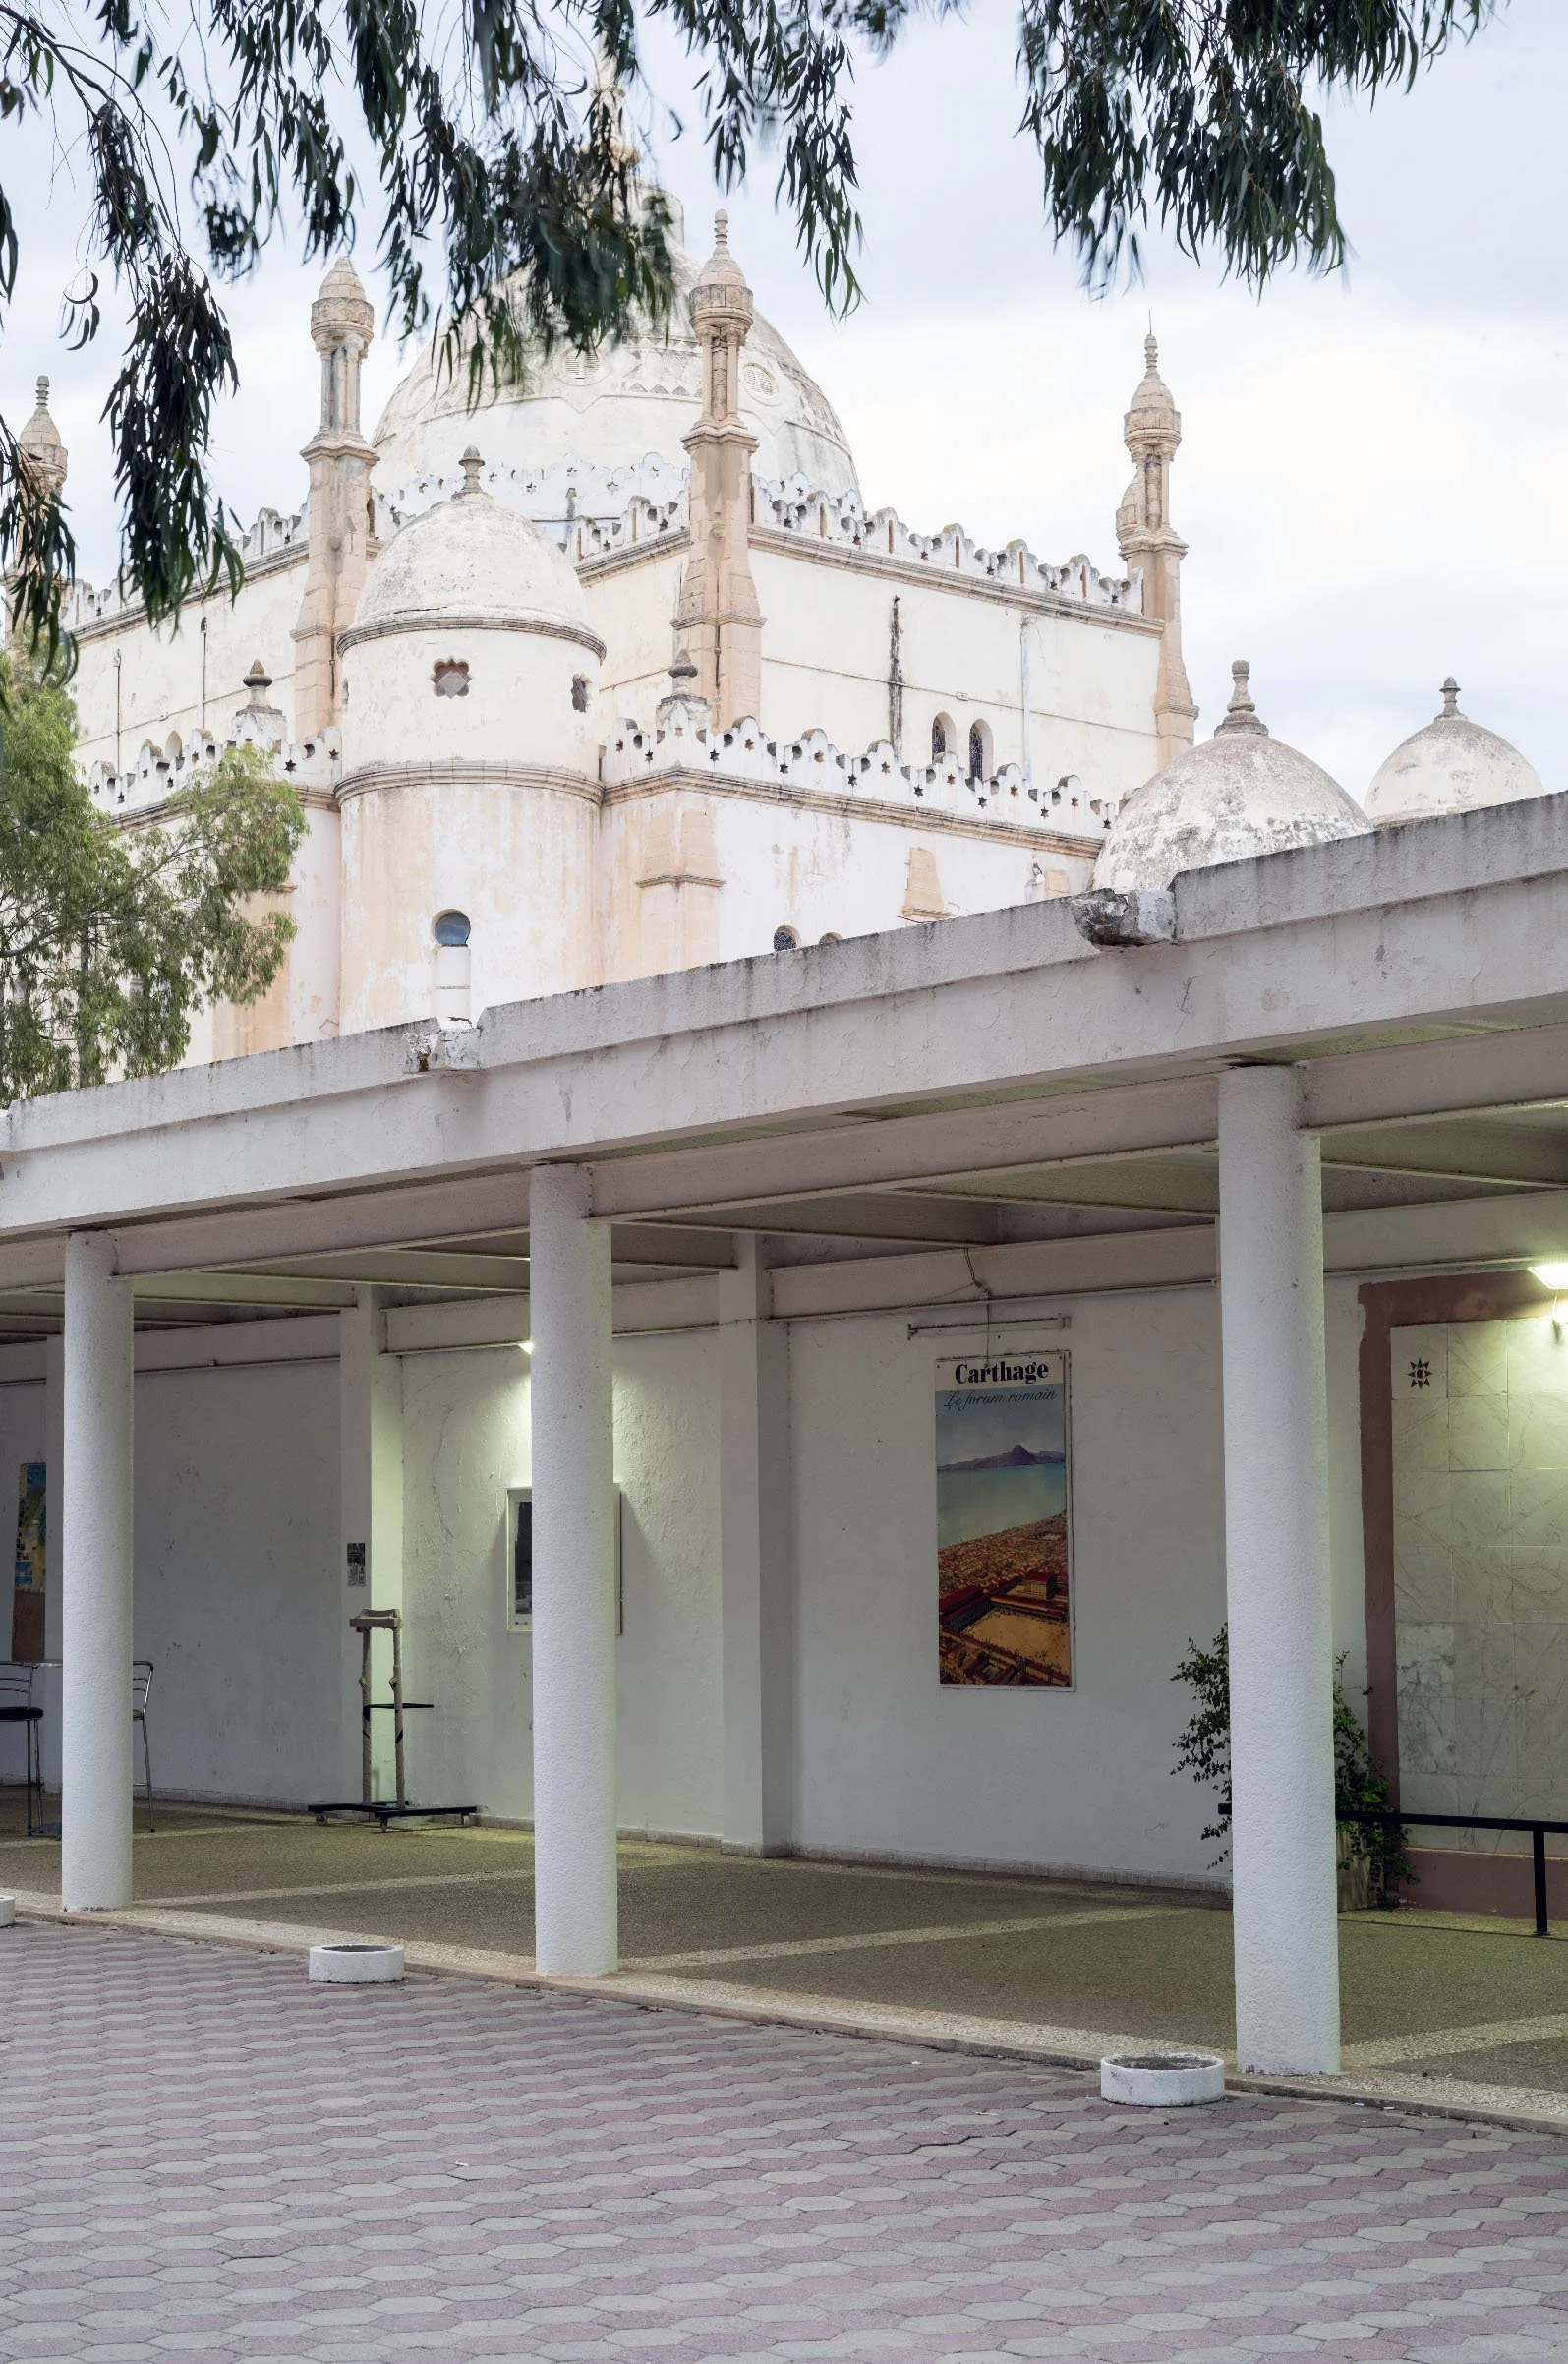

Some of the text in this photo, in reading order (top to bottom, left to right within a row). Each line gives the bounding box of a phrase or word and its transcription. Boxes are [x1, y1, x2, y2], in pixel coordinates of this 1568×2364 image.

[955, 1361, 1049, 1385] Carthage
[944, 1388, 1056, 1411] Le forum romain
